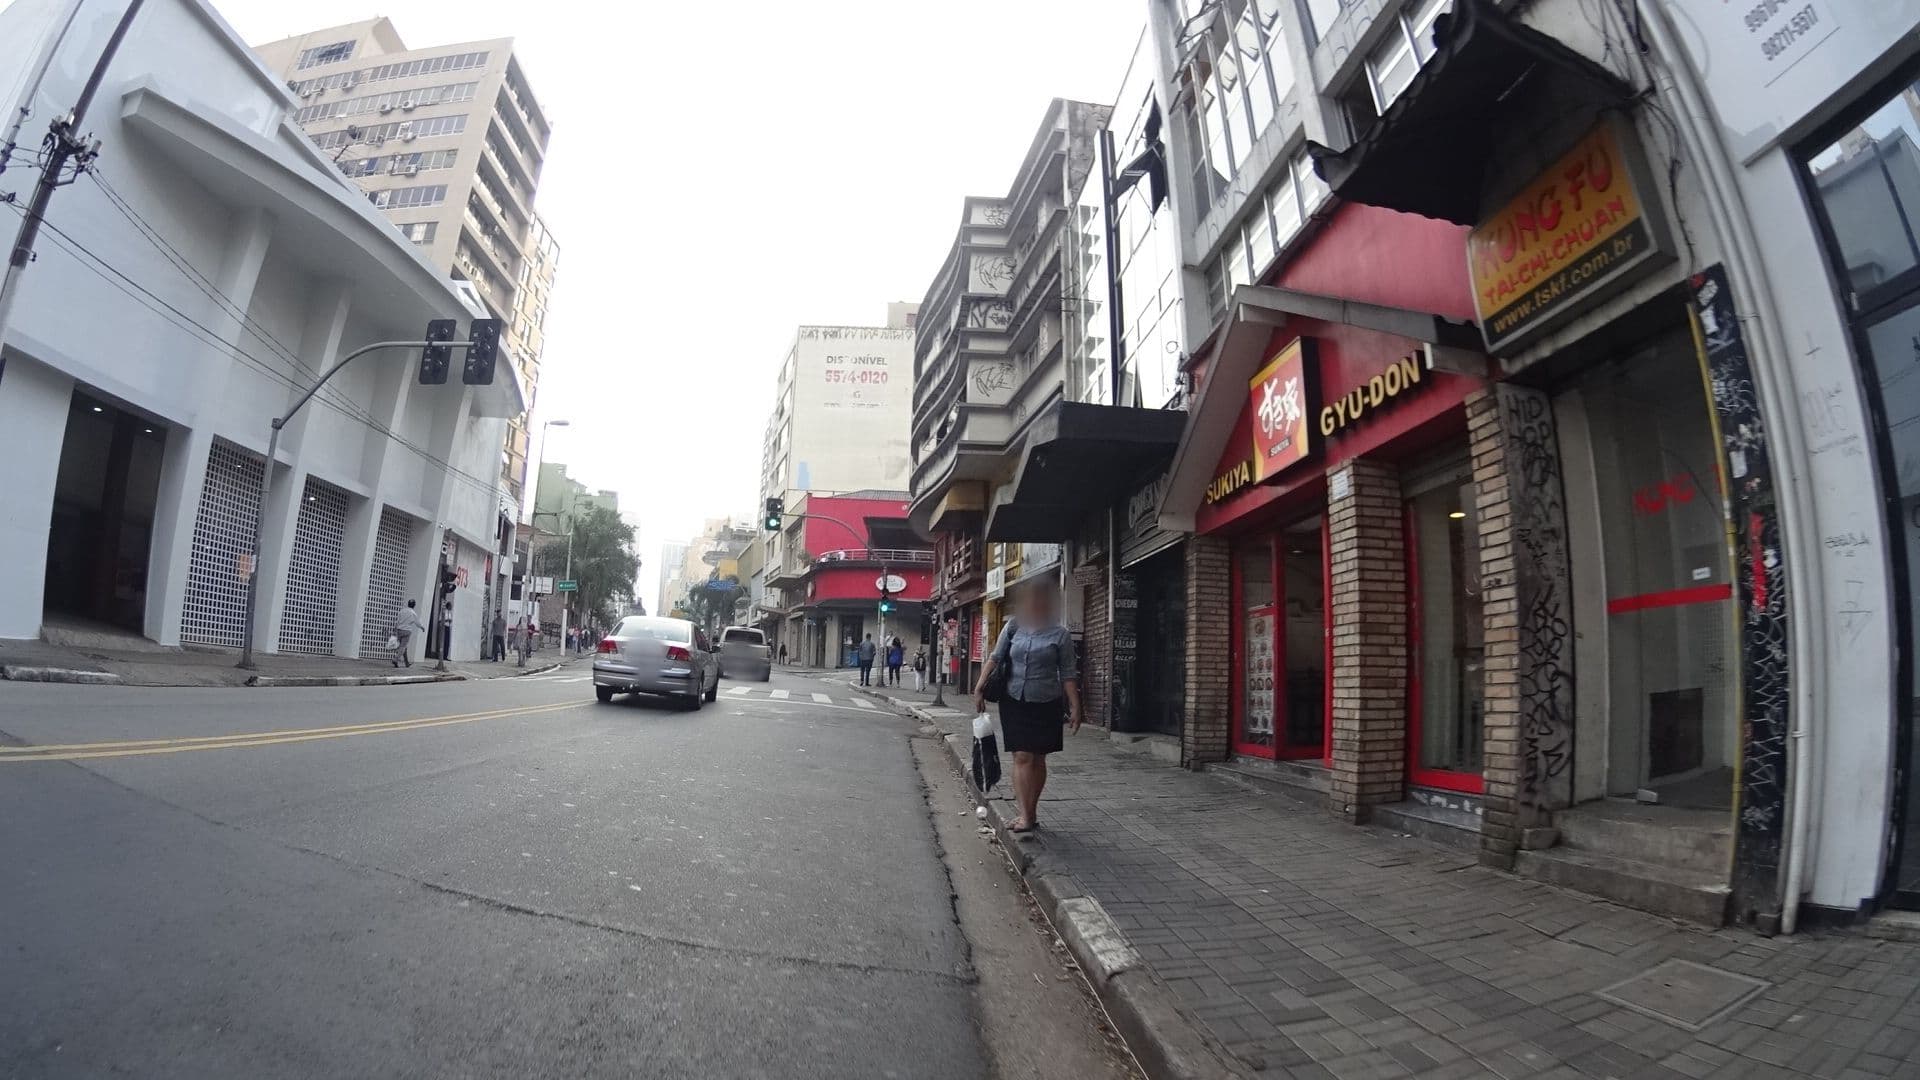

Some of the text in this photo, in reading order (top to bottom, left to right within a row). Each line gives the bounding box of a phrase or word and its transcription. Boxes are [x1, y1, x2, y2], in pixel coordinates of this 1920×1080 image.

[1475, 143, 1614, 279] KUNG FU
[1492, 232, 1634, 334] www.tskf.com.br
[1319, 353, 1422, 437] GYU-DON
[1206, 459, 1251, 505] SUKIYA
